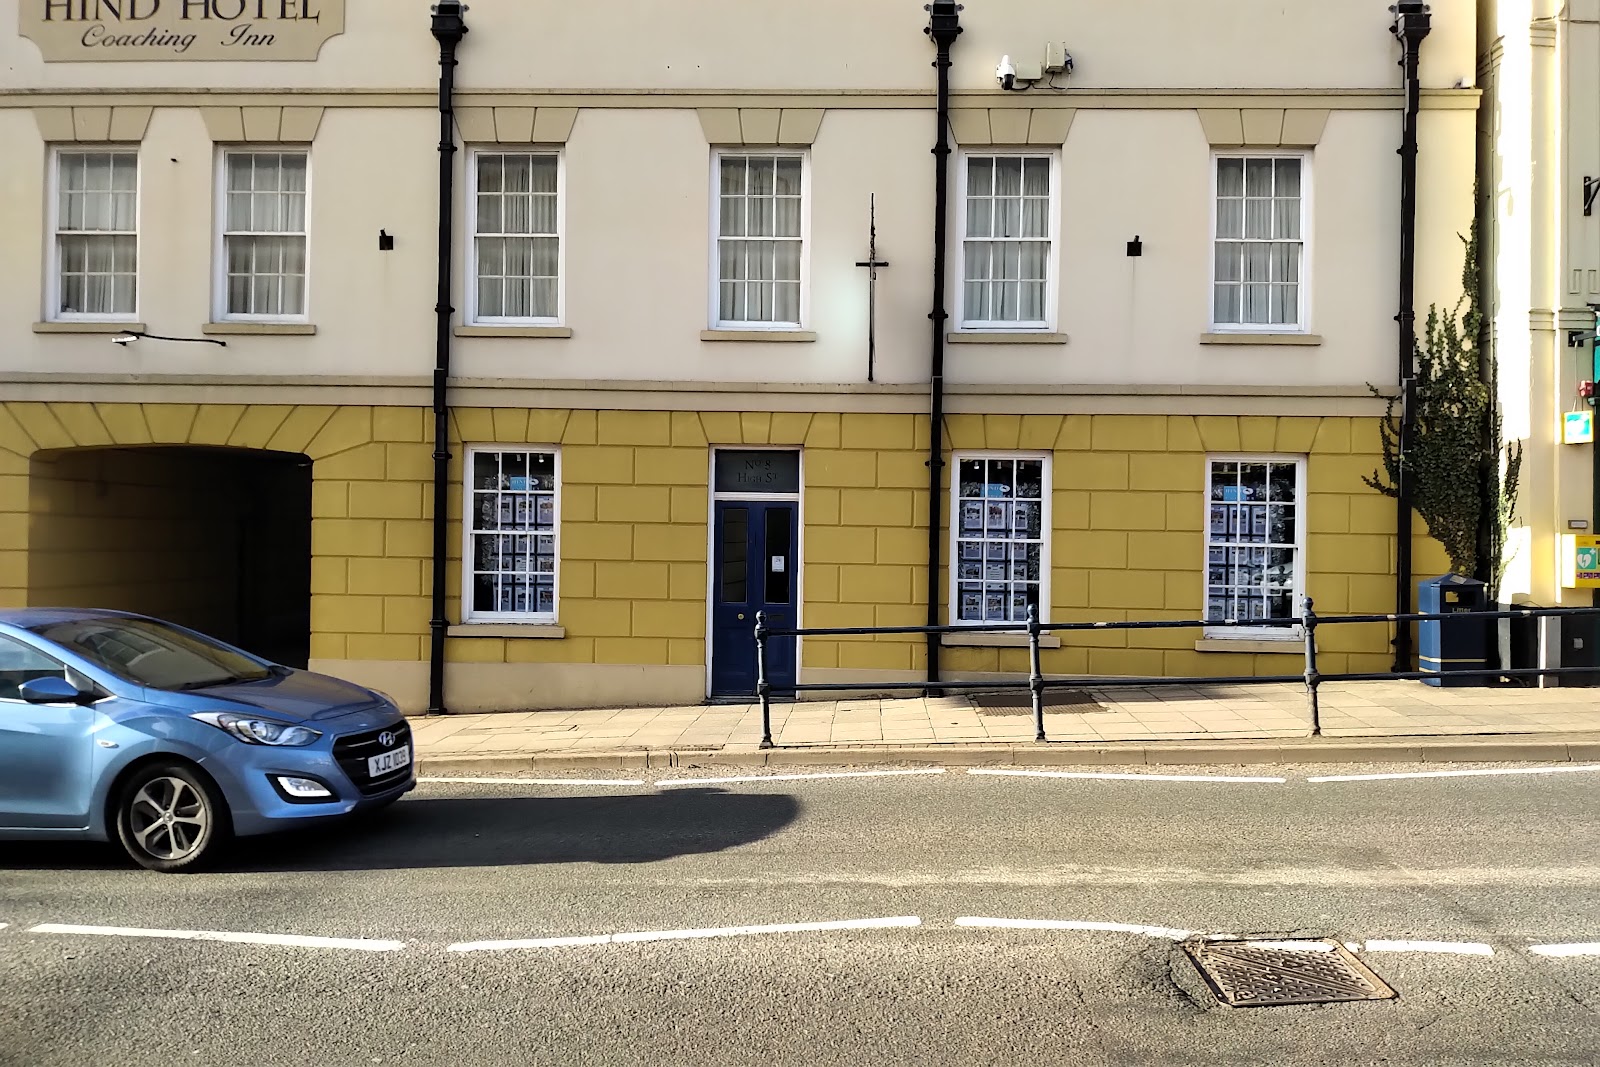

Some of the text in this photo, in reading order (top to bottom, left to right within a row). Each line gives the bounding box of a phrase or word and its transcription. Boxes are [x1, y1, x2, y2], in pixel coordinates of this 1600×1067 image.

[42, 0, 320, 24] HIND HOTEL
[81, 23, 276, 53] Coaching Inn
[764, 460, 771, 470] 8
[374, 754, 392, 773] XJZ
